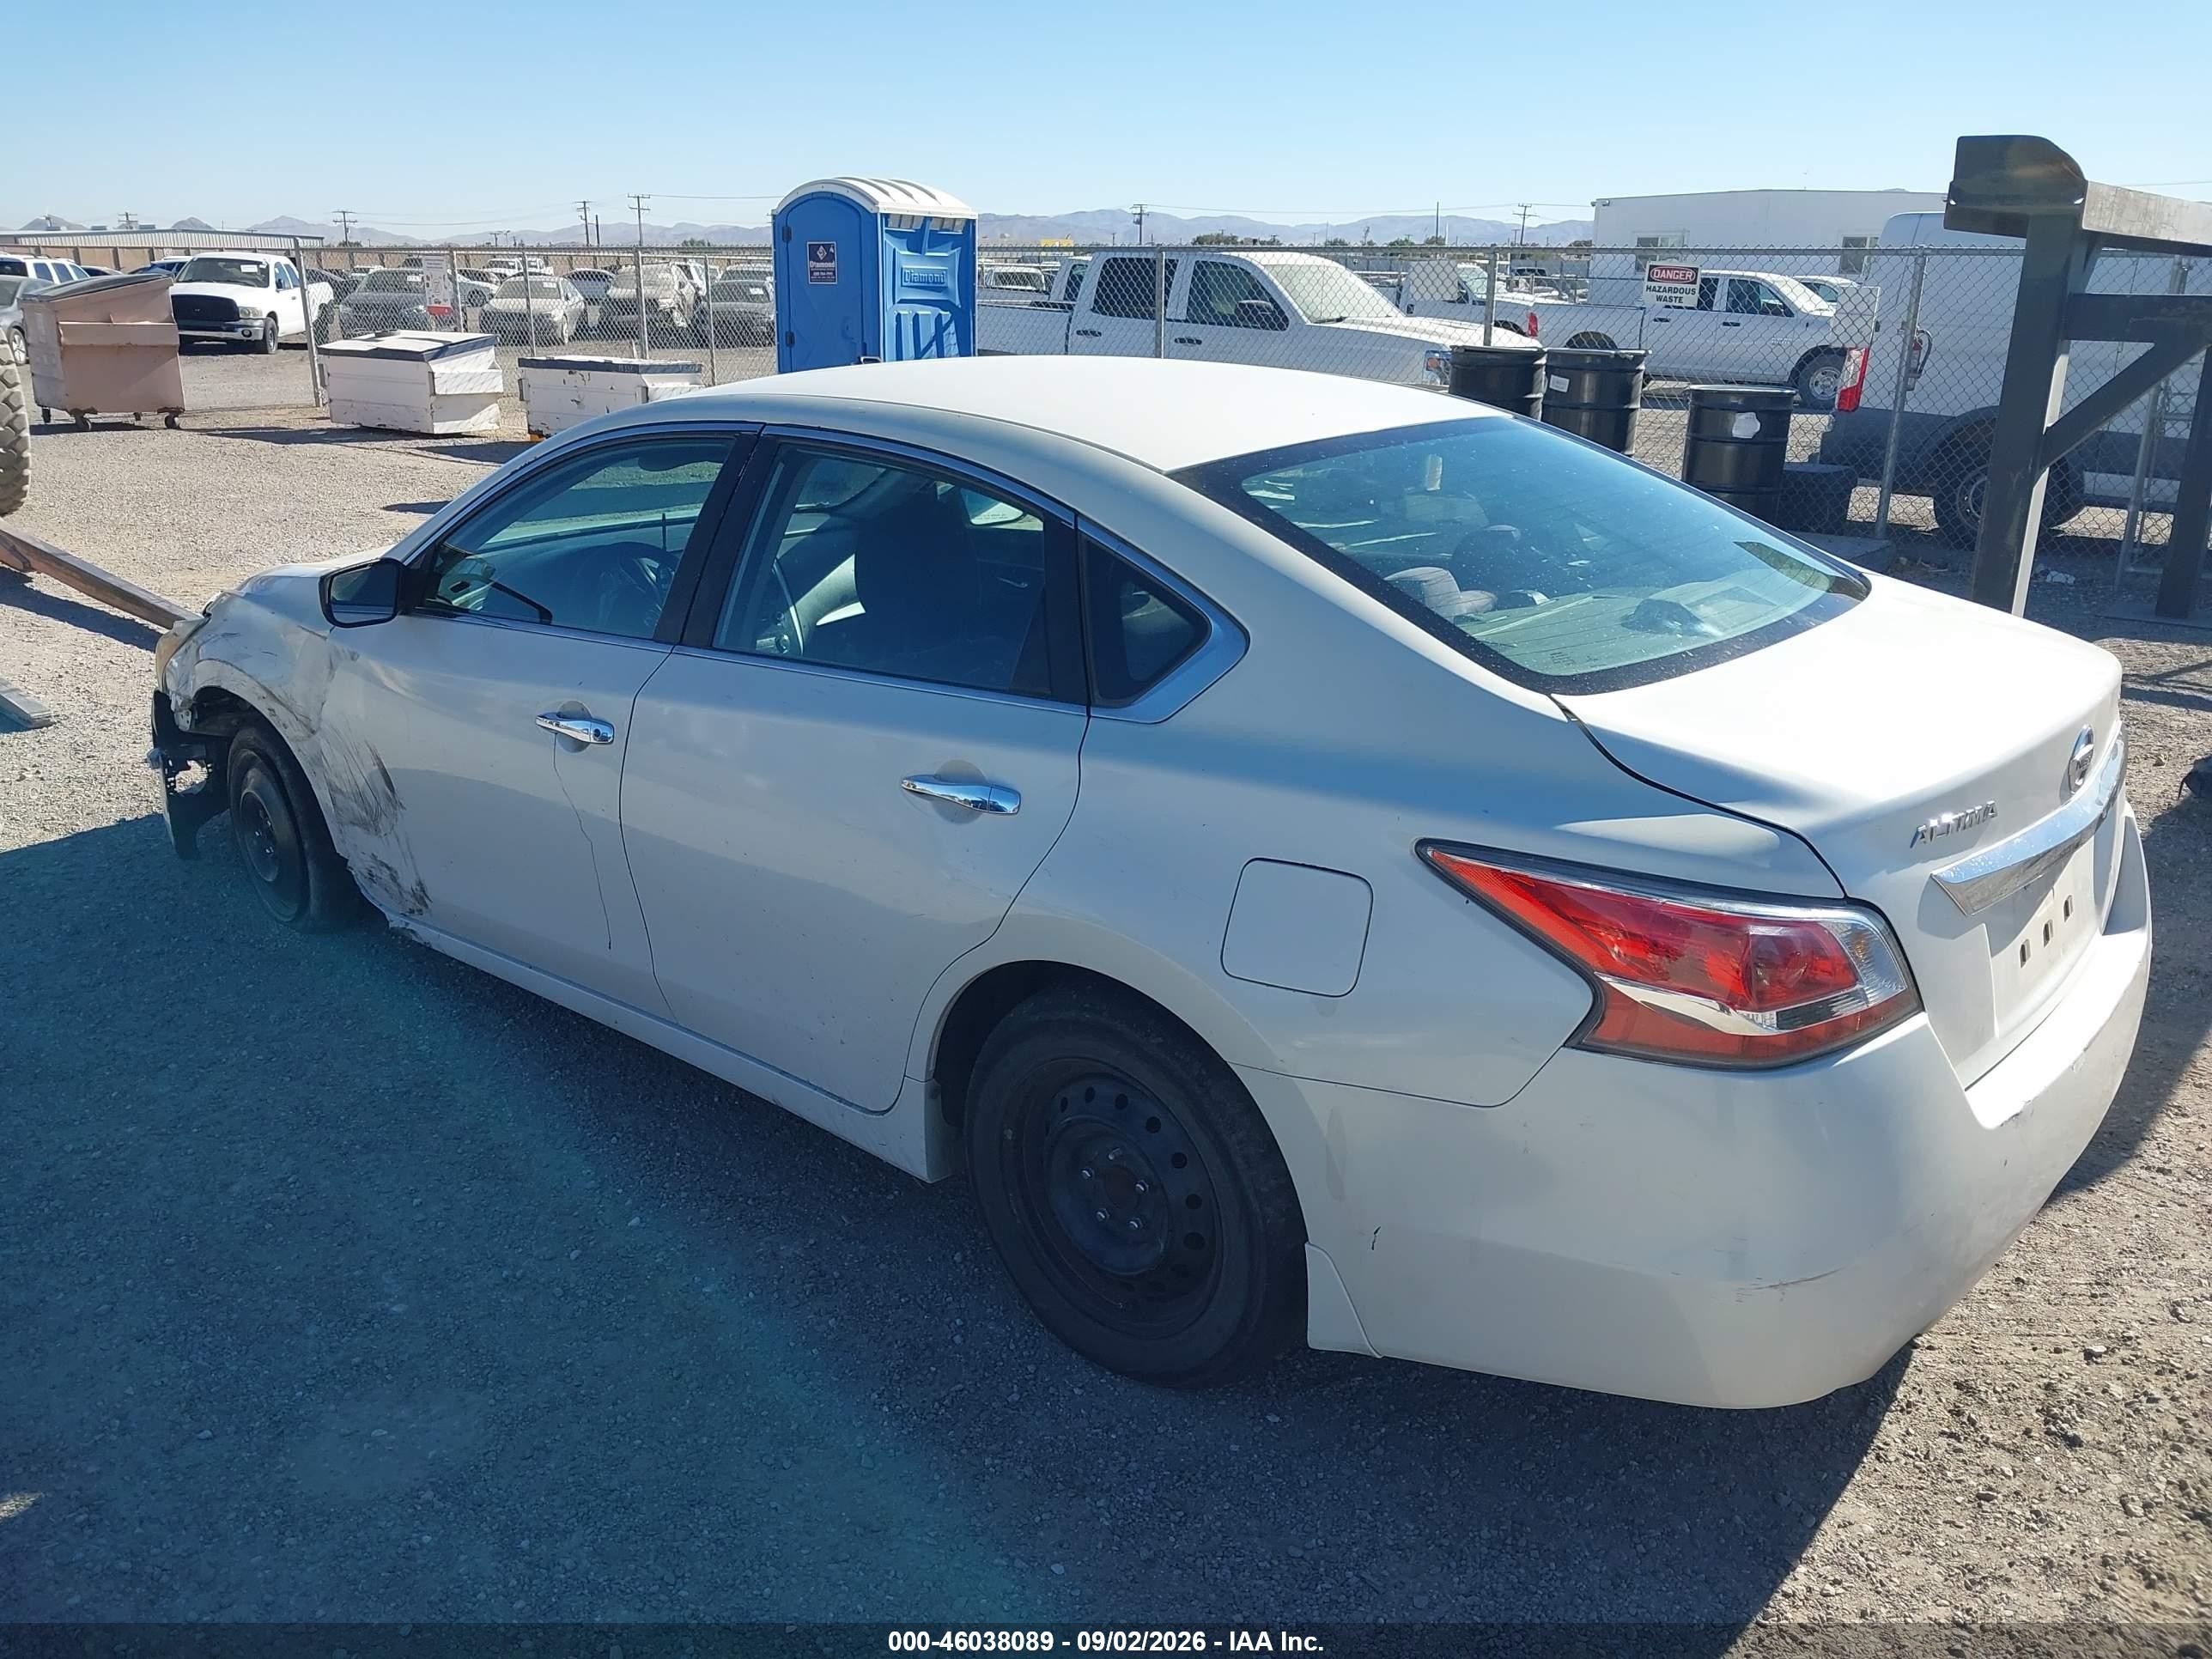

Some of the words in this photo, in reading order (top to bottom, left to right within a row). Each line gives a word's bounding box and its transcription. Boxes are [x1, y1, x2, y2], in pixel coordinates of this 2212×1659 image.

[904, 270, 946, 284] Diamond
[1653, 269, 1693, 281] DANGER
[1645, 285, 1697, 295] HAZARDOUS
[1656, 295, 1683, 303] WASTE
[1910, 800, 1997, 848] ALTIMA
